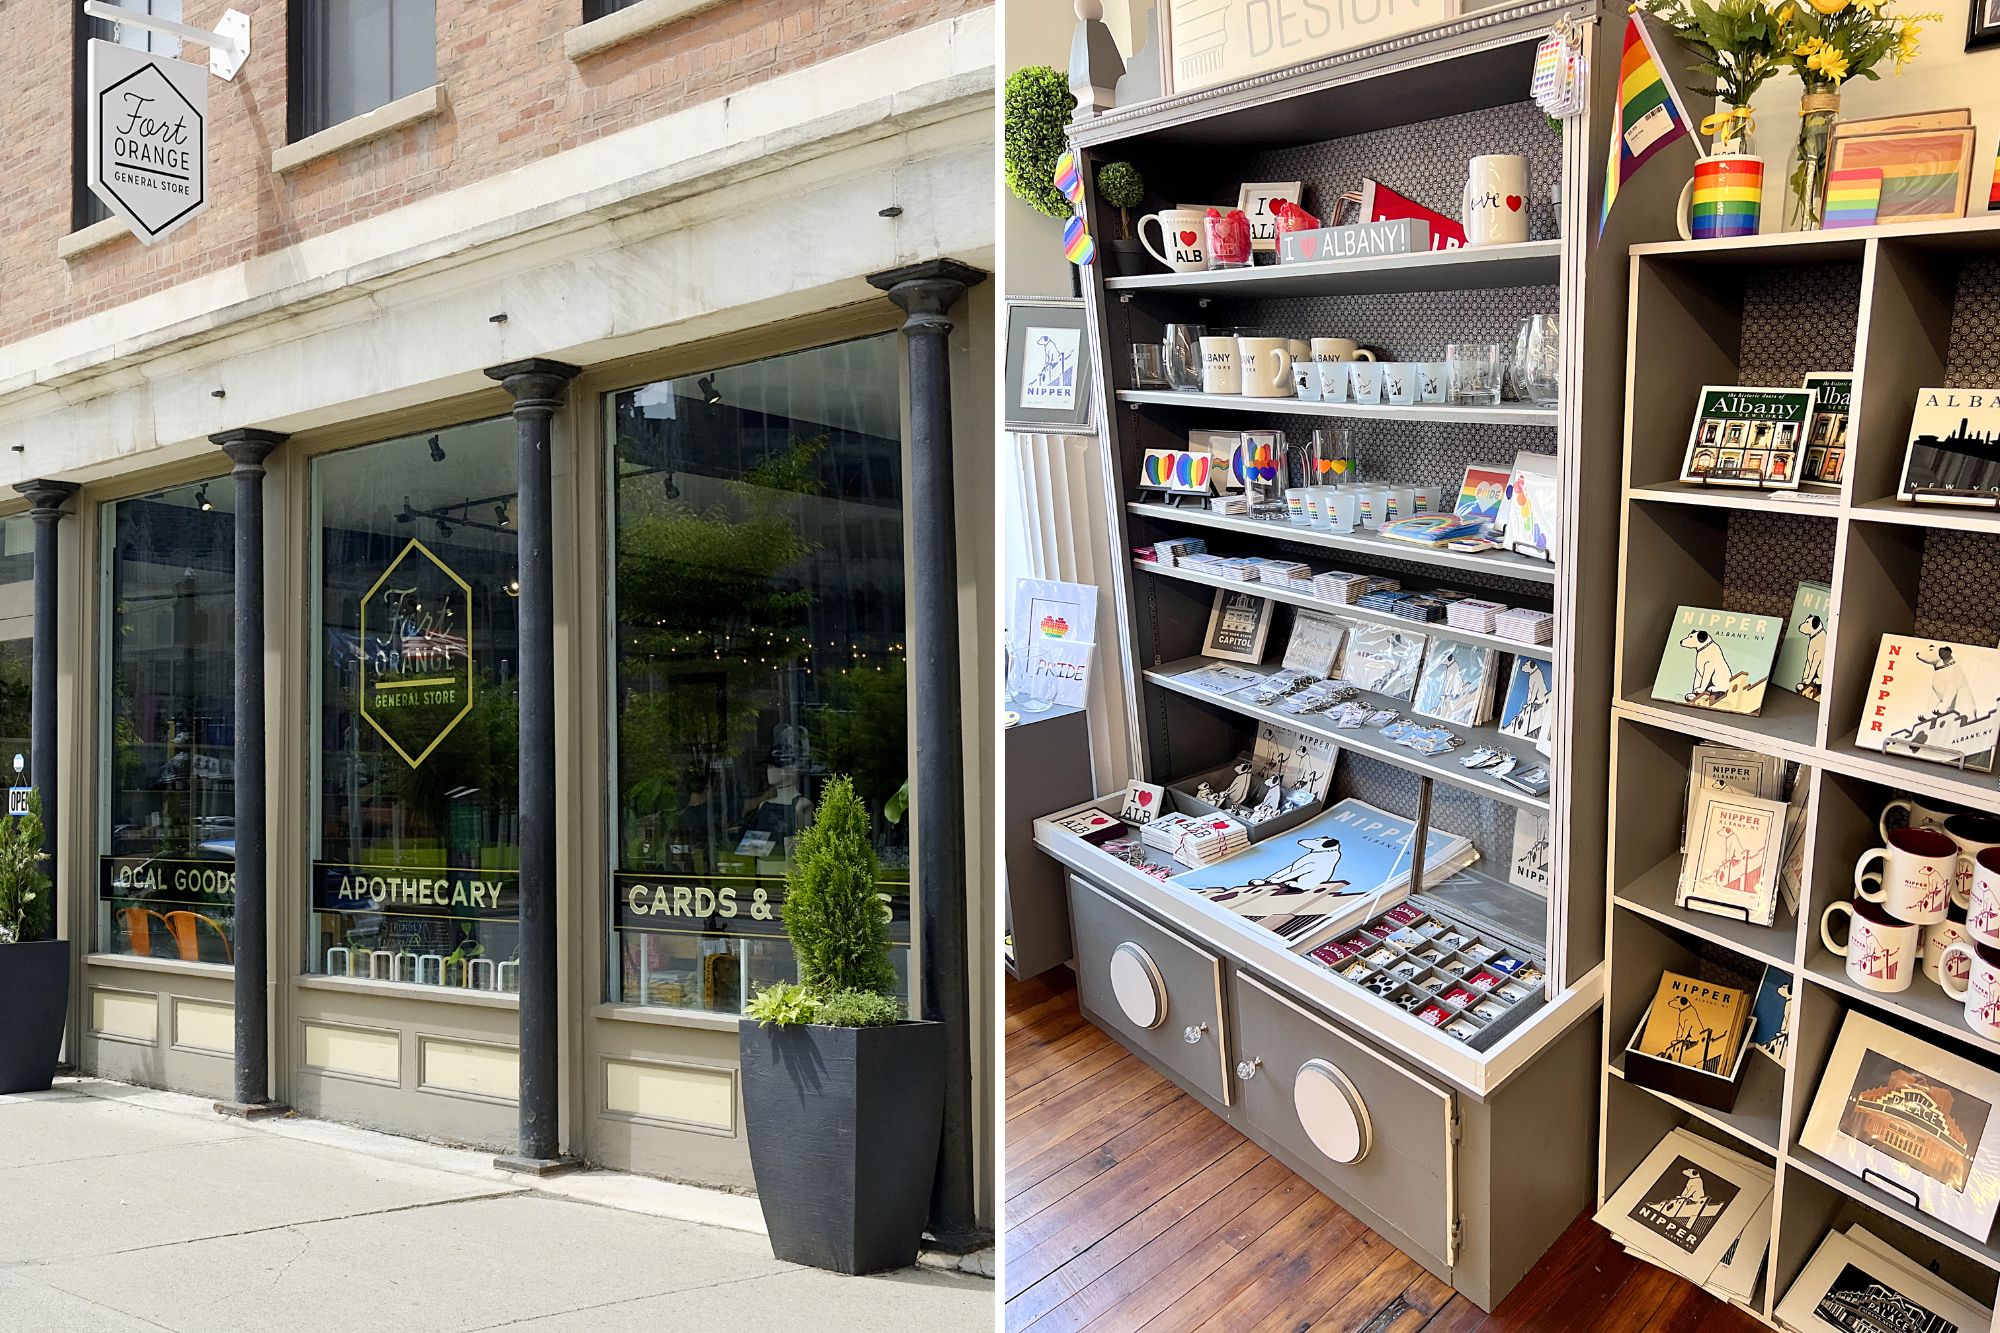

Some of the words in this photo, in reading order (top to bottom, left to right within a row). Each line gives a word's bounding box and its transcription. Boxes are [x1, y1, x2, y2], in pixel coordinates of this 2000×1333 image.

[116, 92, 188, 145] Fort
[114, 137, 190, 171] ORANGE
[114, 171, 158, 189] GENERAL
[161, 181, 190, 195] STORE
[1255, 197, 1268, 216] I
[1172, 231, 1178, 248] I
[1284, 236, 1295, 261] I
[1322, 224, 1406, 257] ALBANY!
[1176, 249, 1203, 263] ALB
[1027, 387, 1071, 397] NIPPER
[1709, 398, 1801, 419] Albany
[1476, 488, 1500, 500] PRIDE
[1682, 611, 1768, 635] NIPPER
[1218, 636, 1252, 648] CAPITOL
[1715, 632, 1750, 641] ALBANY,
[374, 645, 456, 677] ORANGE
[1036, 659, 1086, 681] PRIDE
[1870, 645, 1901, 732] NIPPER
[375, 692, 421, 708] GENERAL
[423, 690, 456, 705] STORE
[1299, 732, 1330, 750] NIPPER
[1951, 732, 1982, 745] ALBANY,
[1982, 728, 1993, 736] NY
[1713, 766, 1750, 776] NIPPER
[1130, 789, 1139, 803] I
[1080, 813, 1098, 821] I
[1120, 806, 1152, 823] ALB
[1719, 811, 1760, 825] NIPPER
[1059, 820, 1090, 834] ALB
[1719, 820, 1748, 829] ALBANY,
[110, 865, 168, 890] LOCAL
[1904, 879, 1928, 888] NIPPER
[338, 876, 503, 909] APOTHECARY
[628, 884, 738, 918] CARDS
[750, 887, 774, 921] &
[1671, 980, 1731, 1004] NIPPER
[1893, 1095, 1938, 1124] PALACE
[1638, 1206, 1698, 1246] NIPPER
[1867, 1302, 1910, 1331] PALACE
